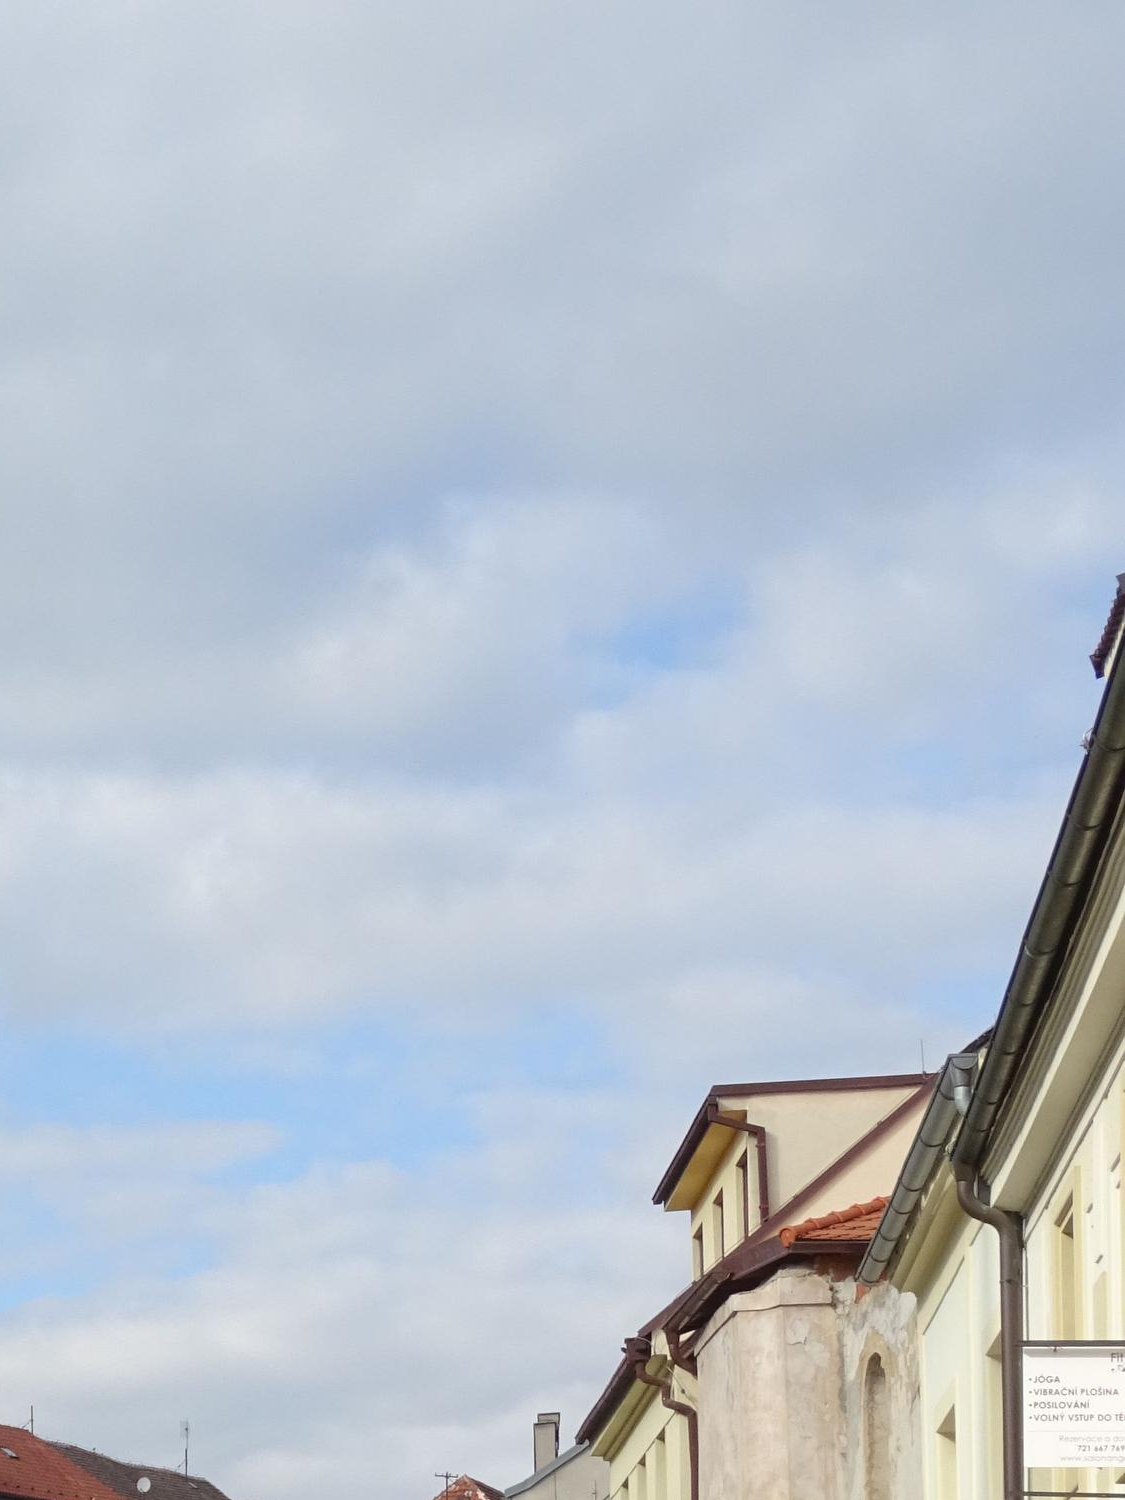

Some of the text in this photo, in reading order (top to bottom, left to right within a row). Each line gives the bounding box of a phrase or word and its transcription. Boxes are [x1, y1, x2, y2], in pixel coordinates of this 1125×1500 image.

[1033, 1387, 1120, 1396] VIBRAČNÍ PLOŠINA
[1068, 1414, 1095, 1422] VSTUP
[1097, 1414, 1113, 1422] DO
